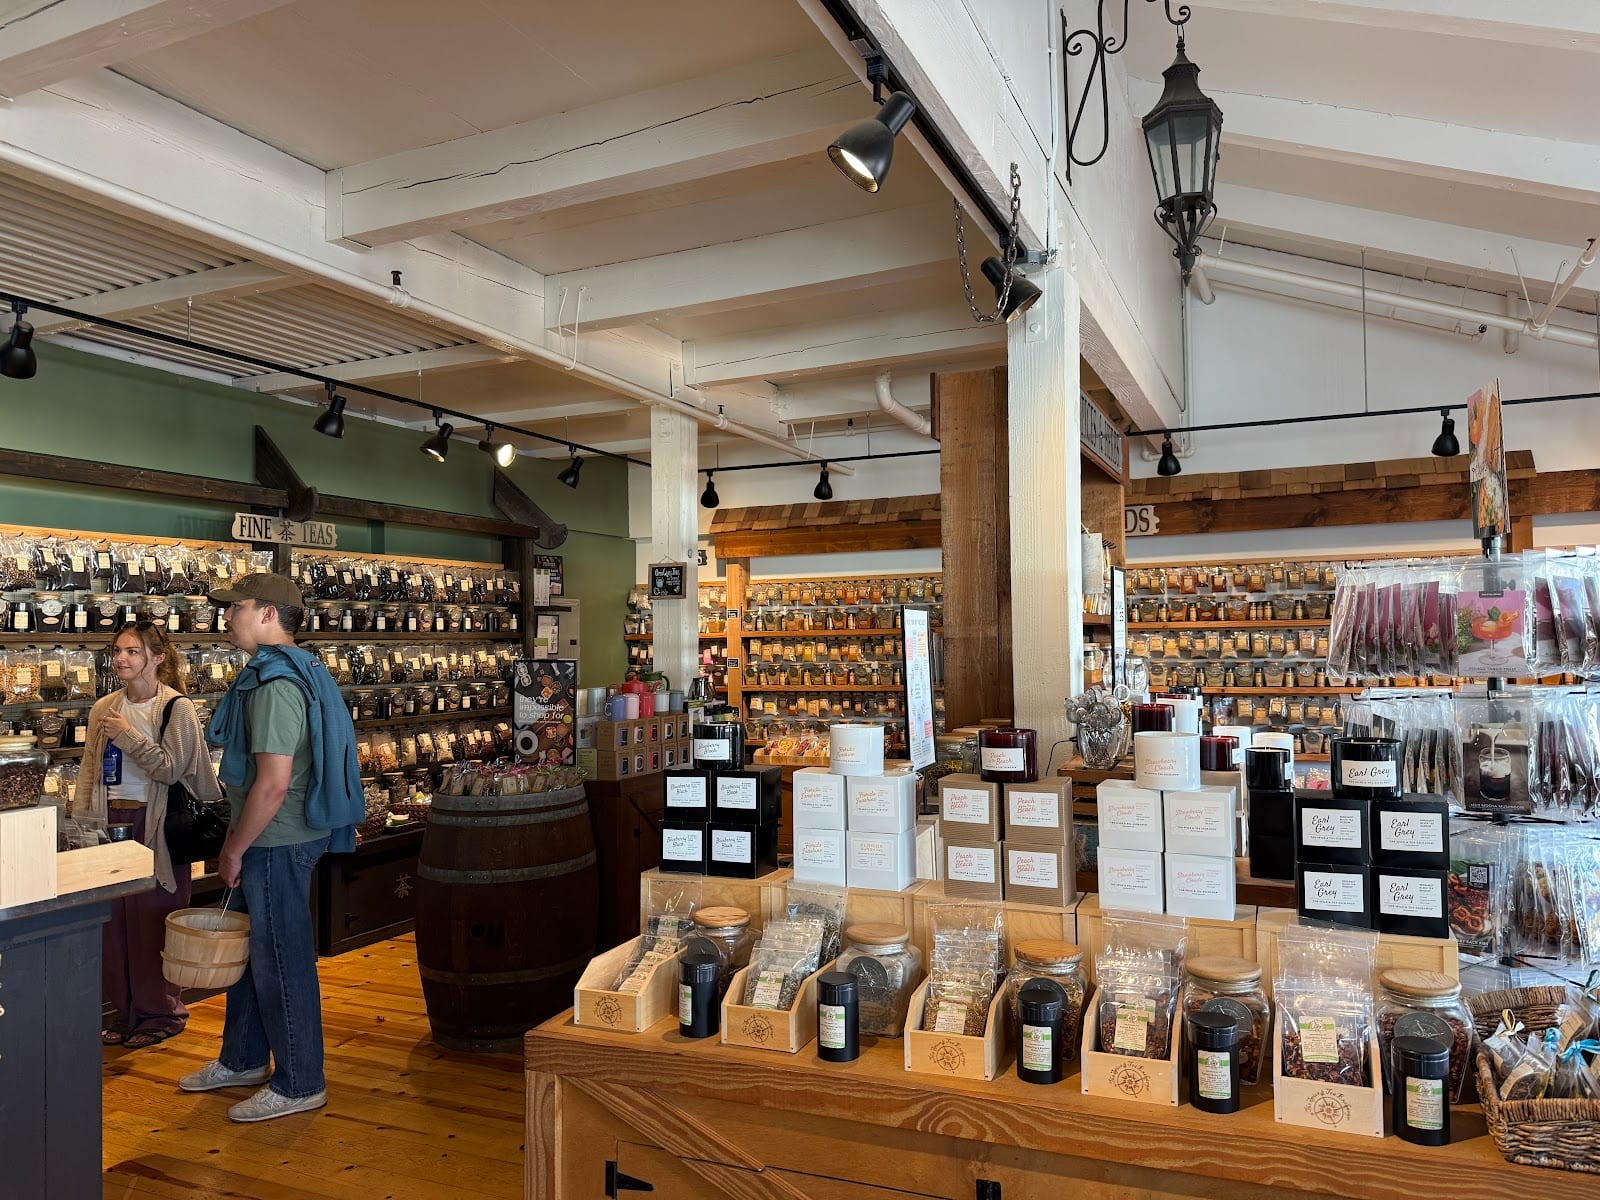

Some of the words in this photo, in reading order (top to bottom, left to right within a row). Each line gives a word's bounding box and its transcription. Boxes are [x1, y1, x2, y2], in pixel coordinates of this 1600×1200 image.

[240, 516, 271, 539] FINE
[278, 521, 296, 541] 茶
[301, 523, 333, 545] TEAS
[520, 696, 548, 704] they're
[520, 703, 564, 713] impossible
[529, 711, 549, 720] shop
[552, 712, 564, 720] for
[1348, 768, 1367, 778] Earl
[1371, 767, 1390, 778] Grey
[1017, 796, 1035, 805] Peach
[1017, 805, 1036, 813] Beach
[1312, 815, 1329, 825] Earl
[1391, 818, 1409, 829] Earl
[1315, 824, 1335, 834] Grey
[1395, 827, 1414, 839] Grey
[1314, 879, 1331, 889] Earl
[1390, 883, 1408, 893] Earl
[1317, 888, 1337, 899] Grey
[1394, 892, 1414, 903] Grey
